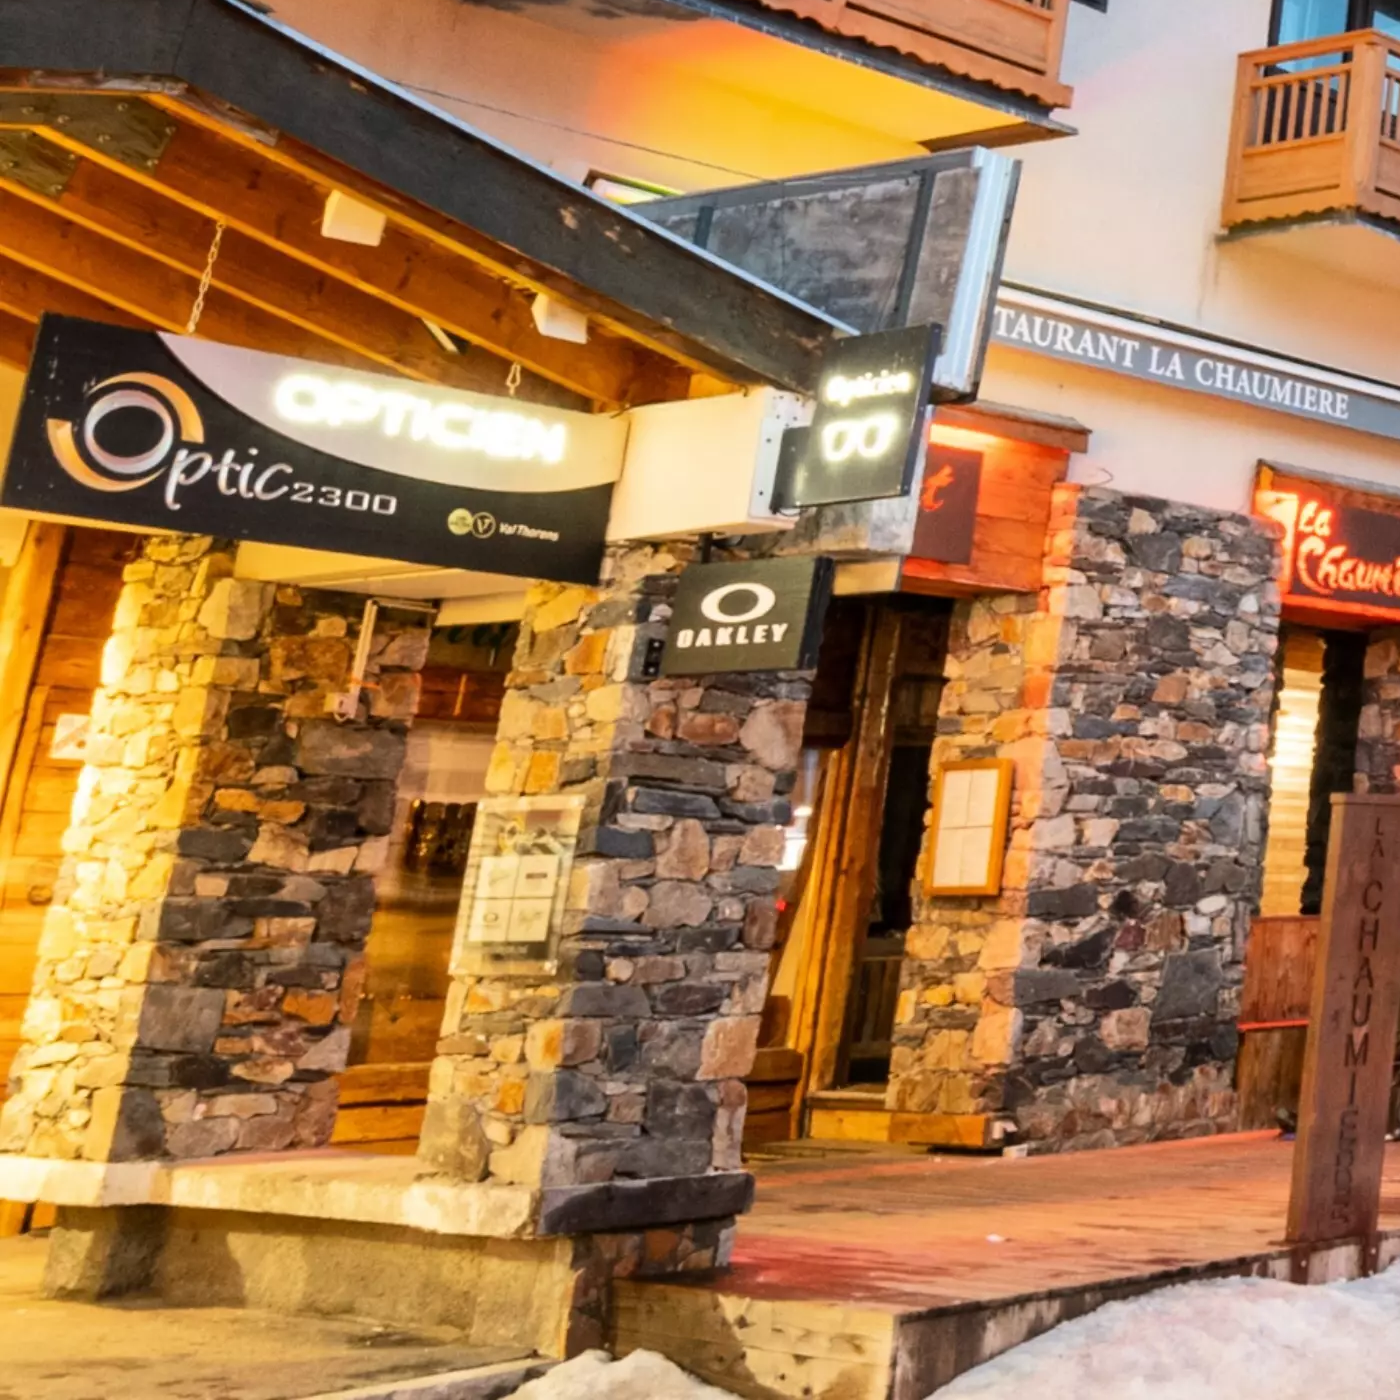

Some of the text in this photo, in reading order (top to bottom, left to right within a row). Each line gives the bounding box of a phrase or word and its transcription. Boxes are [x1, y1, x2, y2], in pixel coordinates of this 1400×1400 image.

[1148, 346, 1185, 380] LA
[1195, 358, 1350, 420] CHAUMIERE
[274, 374, 566, 463] OPTICIEN
[1298, 500, 1333, 537] La
[676, 622, 789, 649] OAKLEY
